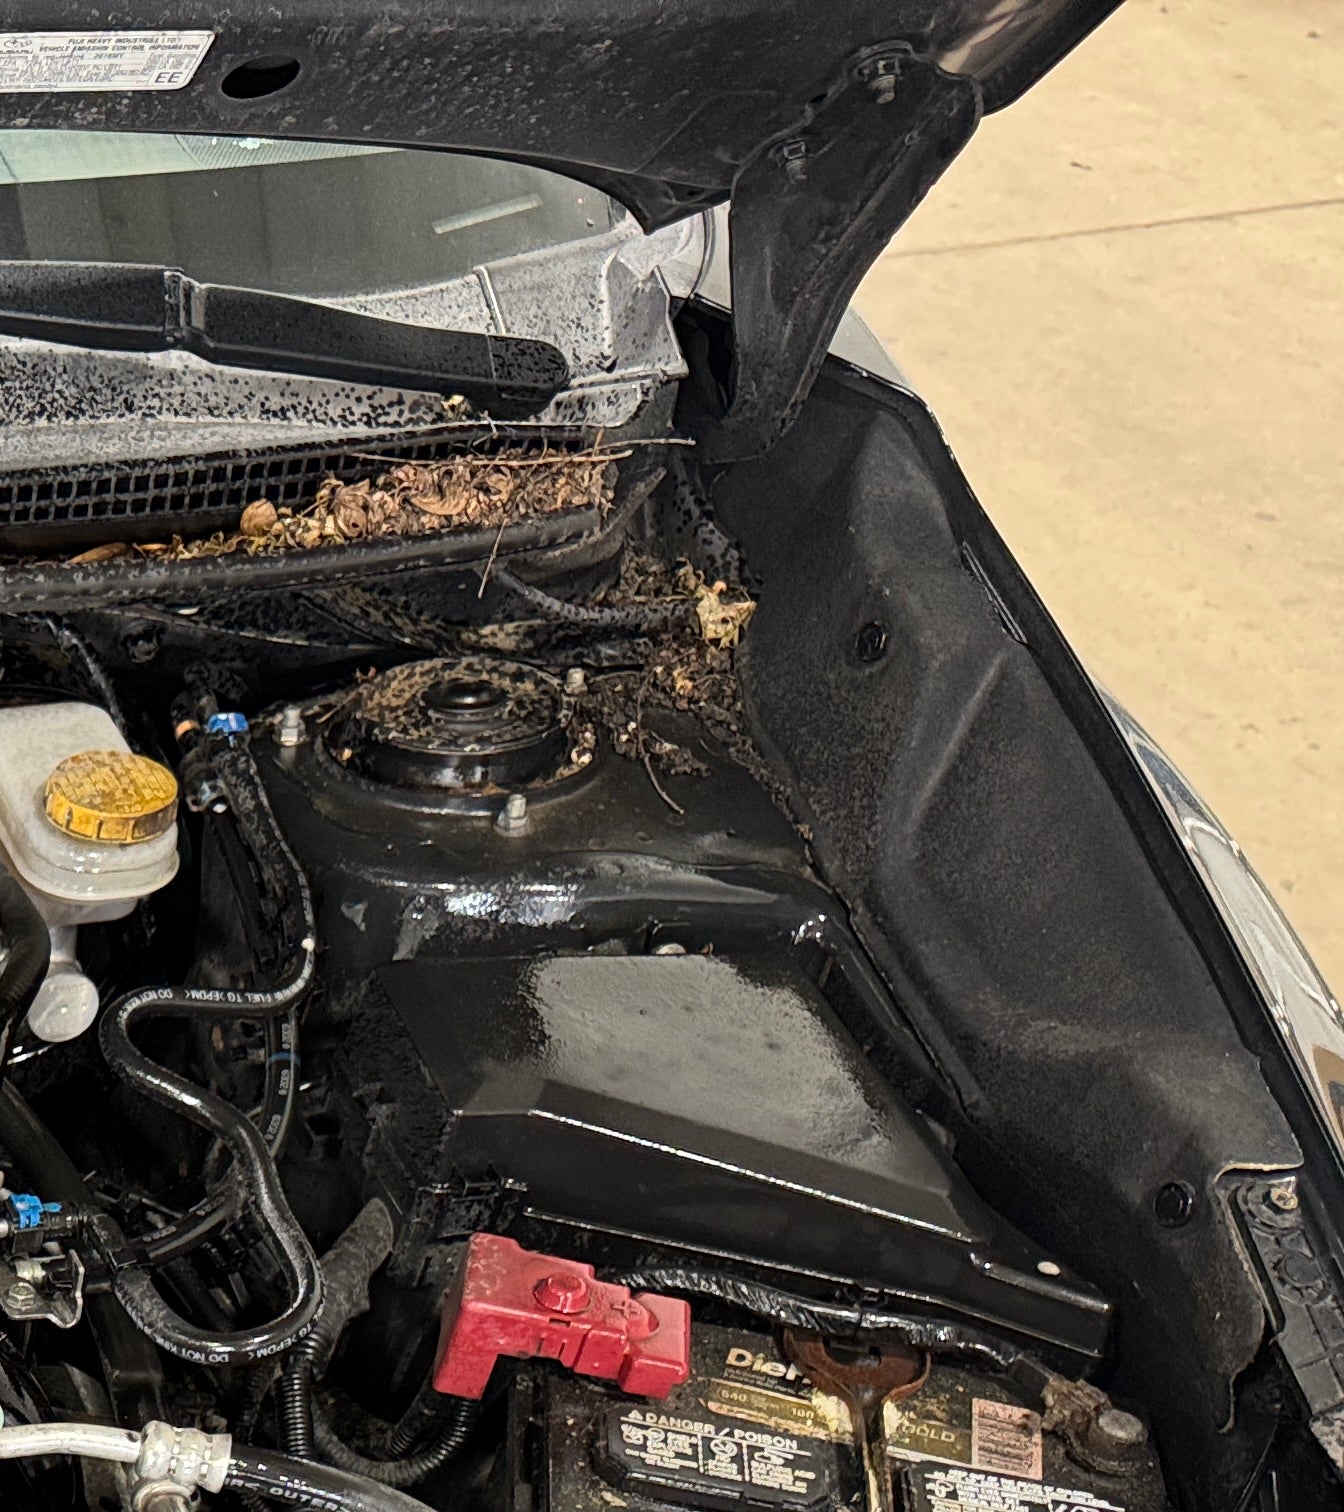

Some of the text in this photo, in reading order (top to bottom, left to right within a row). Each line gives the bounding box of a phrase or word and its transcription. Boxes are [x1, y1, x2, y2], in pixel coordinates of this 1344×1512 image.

[155, 71, 181, 83] EE
[208, 1353, 229, 1363] DO
[726, 1348, 815, 1385] DieH
[646, 1412, 716, 1435] DANGER
[733, 1428, 799, 1450] POISON
